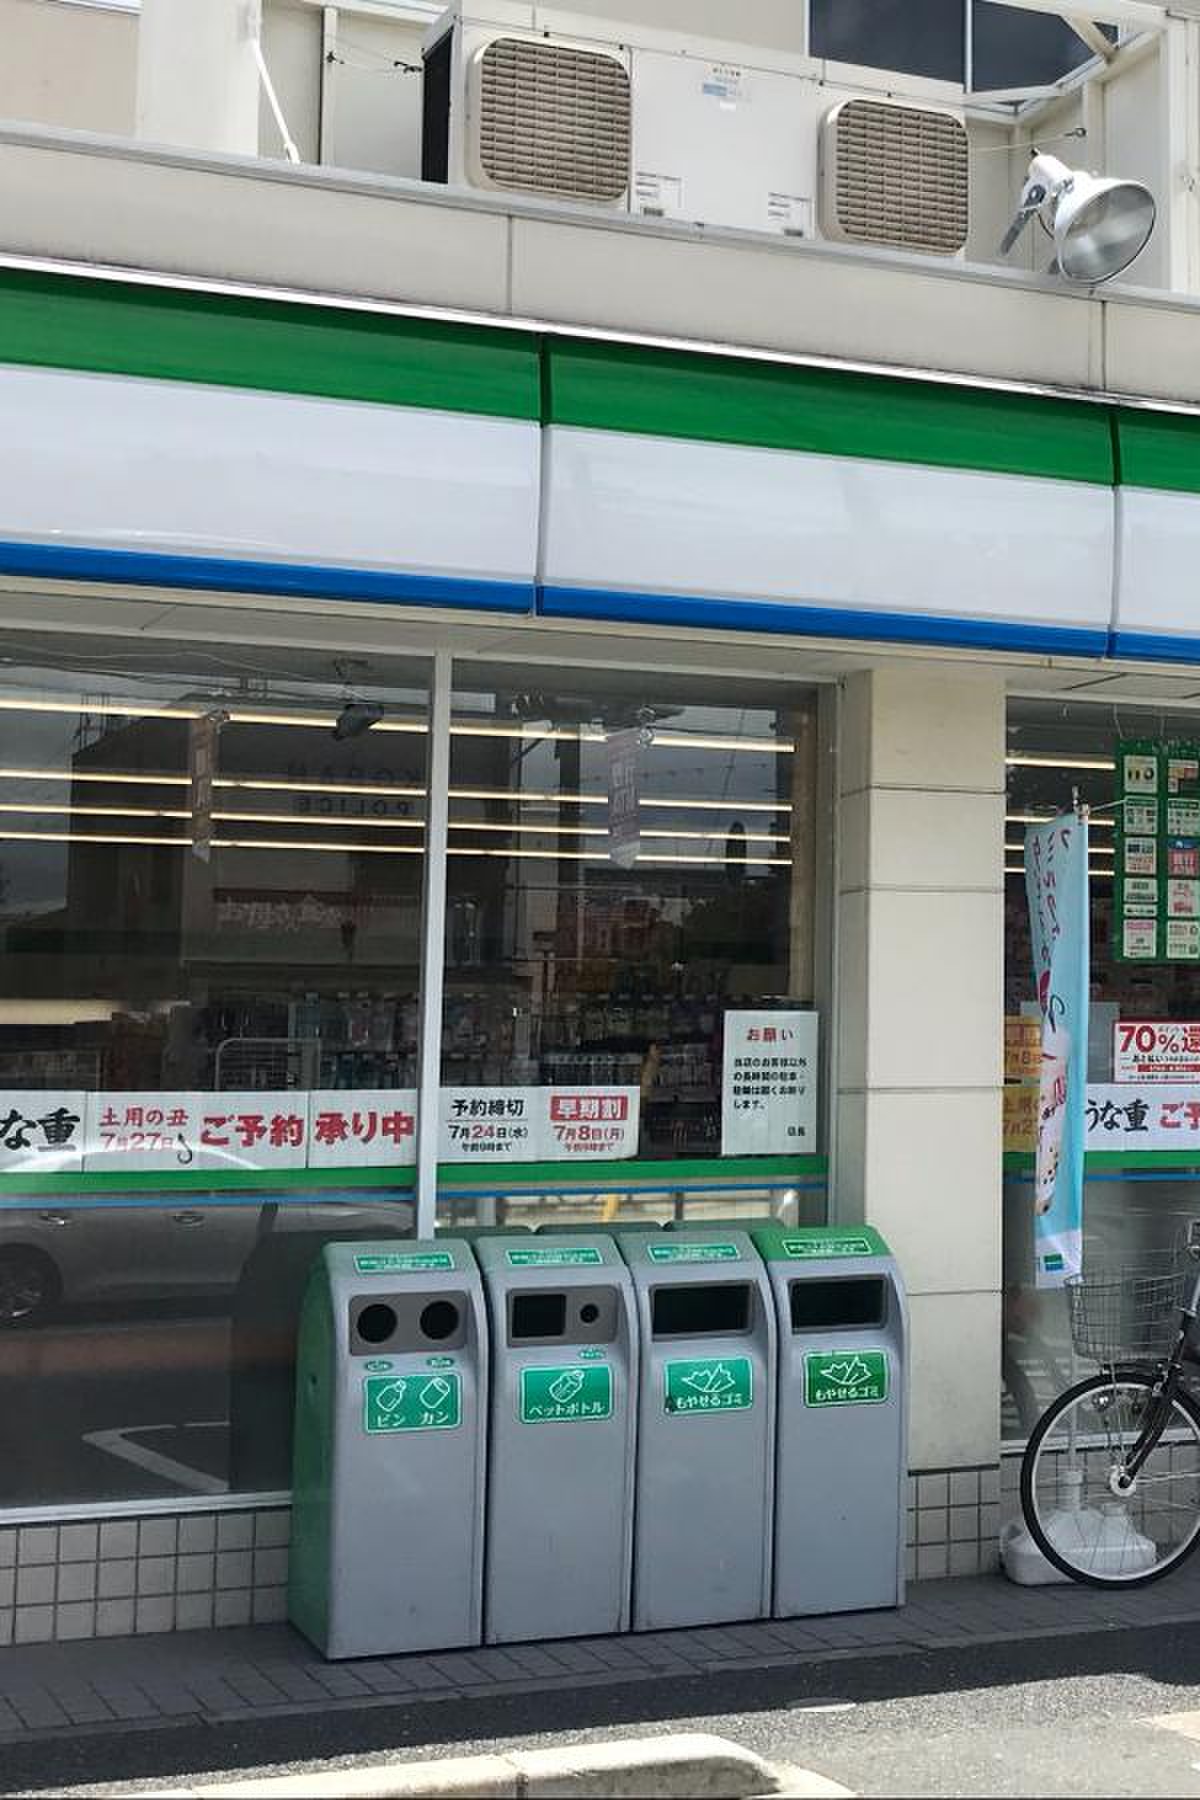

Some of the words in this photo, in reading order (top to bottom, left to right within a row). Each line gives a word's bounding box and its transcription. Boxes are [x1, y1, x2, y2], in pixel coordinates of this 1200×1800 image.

[746, 1027, 794, 1042] お願い
[101, 1106, 189, 1127] 土用の丑
[452, 1099, 525, 1117] 予約締切
[557, 1099, 622, 1120] 早期割
[1085, 1098, 1149, 1132] うな重
[201, 1113, 305, 1148] ご予約
[315, 1111, 415, 1145] 承り中
[102, 1132, 174, 1152] 7月27日
[529, 1401, 606, 1417] ペットボトル
[376, 1414, 406, 1428] ビン
[420, 1411, 450, 1426] カン
